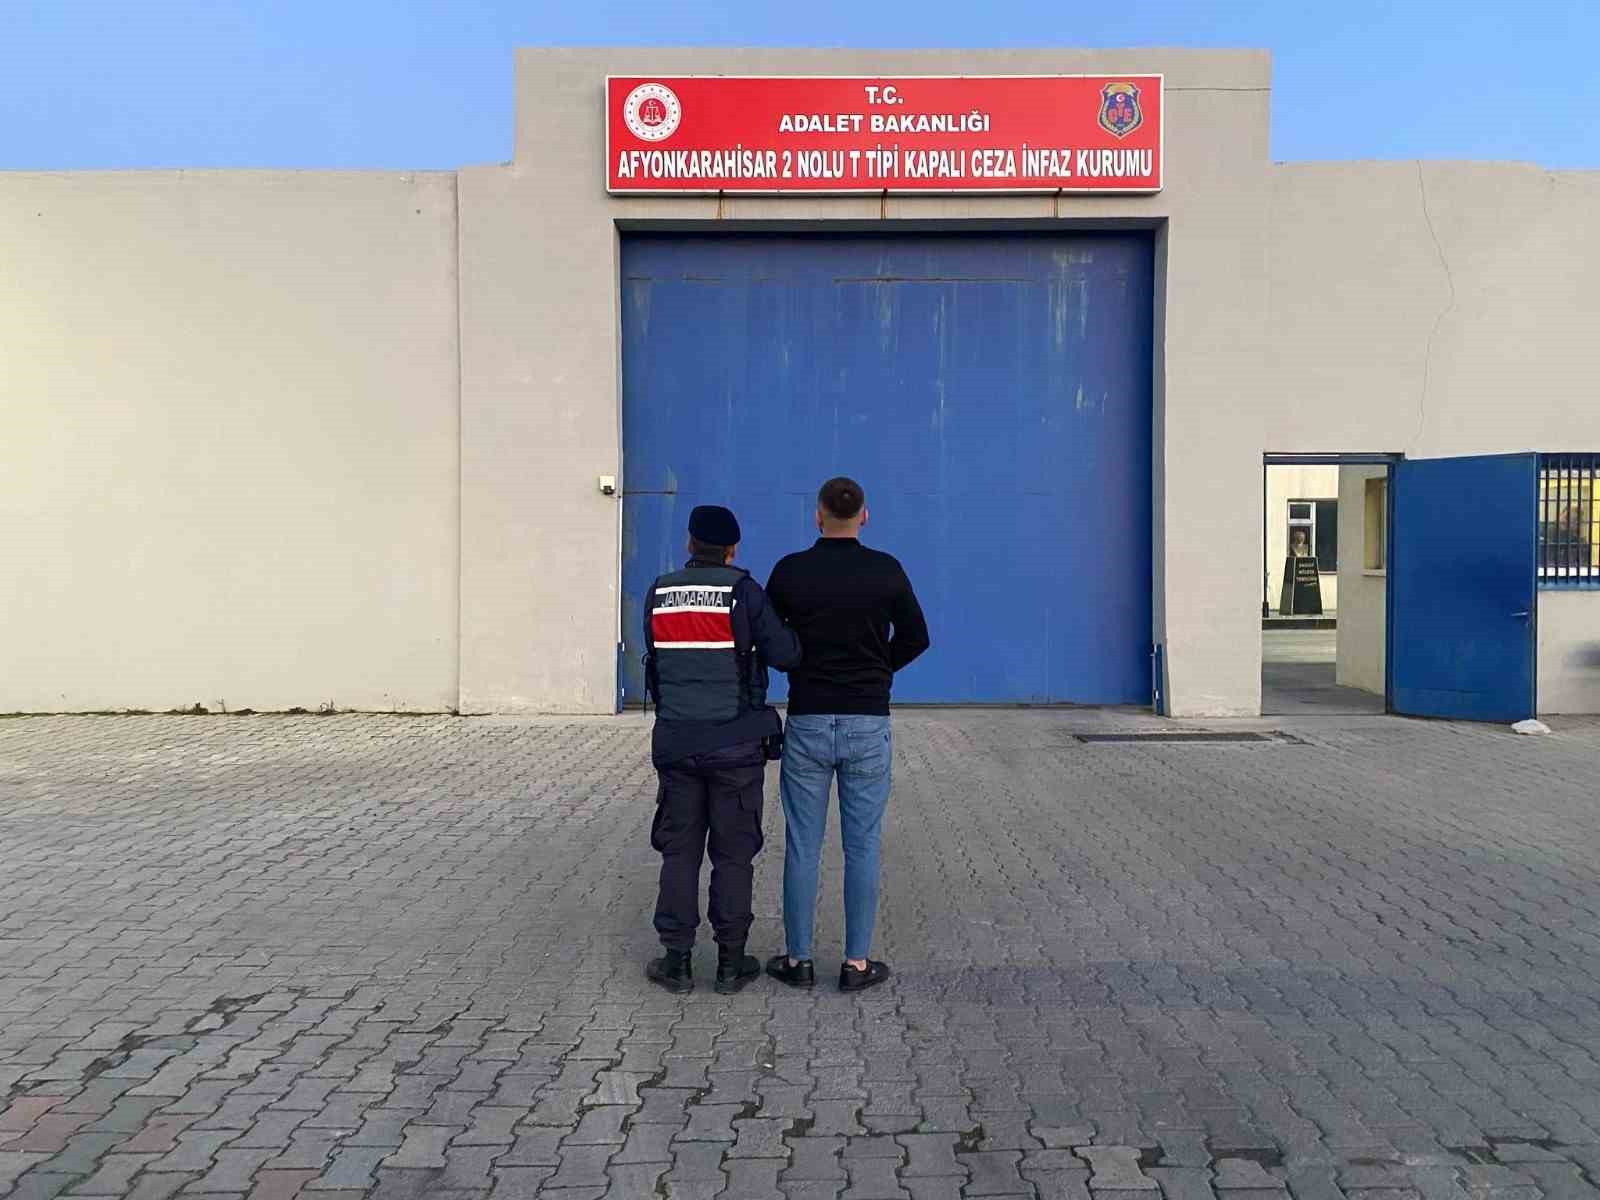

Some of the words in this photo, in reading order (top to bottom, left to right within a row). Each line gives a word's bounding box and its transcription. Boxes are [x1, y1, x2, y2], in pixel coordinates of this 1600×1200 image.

[864, 86, 904, 106] T.C.
[778, 114, 864, 133] ADALET
[870, 109, 991, 133] BAKANLIĞI
[617, 144, 777, 179] AFYONKARAHİSAR
[782, 150, 792, 178] 2
[797, 150, 845, 178] NOLU
[849, 150, 861, 178] T
[865, 144, 899, 178] TİPİ
[903, 150, 967, 178] KAPALI
[971, 150, 1017, 178] CEZA
[1022, 144, 1072, 178] İNFAZ
[1076, 149, 1154, 178] KURUMU
[661, 591, 724, 607] JANDARMA
